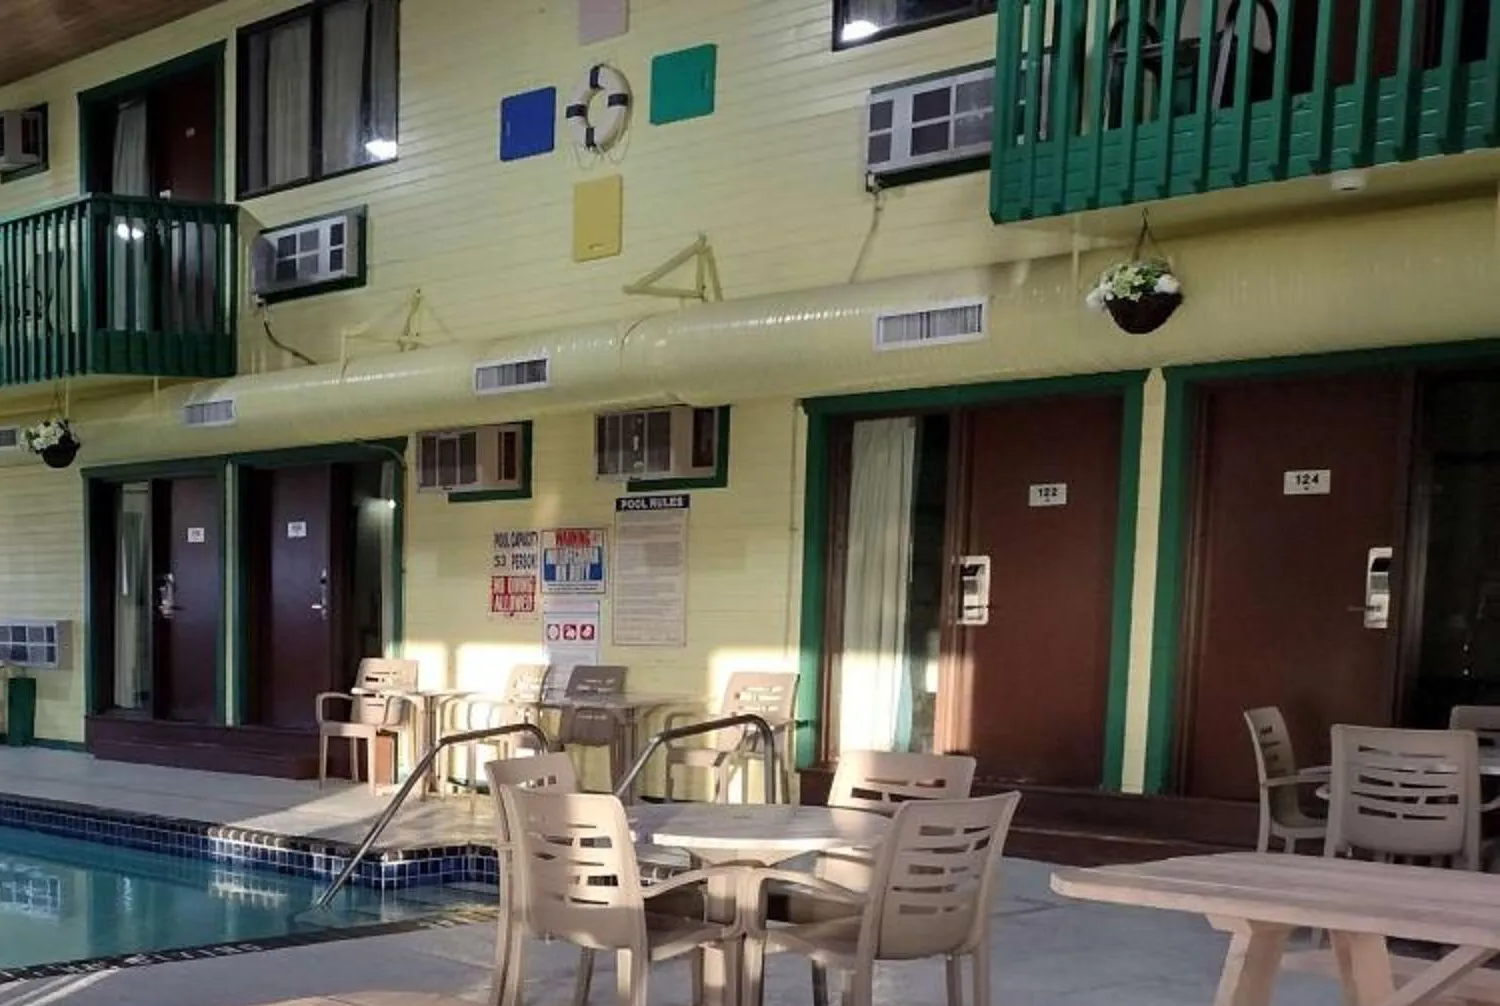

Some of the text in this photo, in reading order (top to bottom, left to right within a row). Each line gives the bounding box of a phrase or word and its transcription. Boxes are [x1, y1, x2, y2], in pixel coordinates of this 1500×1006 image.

[1295, 474, 1320, 485] 124
[1038, 487, 1058, 497] 122
[621, 496, 684, 510] POOL RULES
[494, 554, 507, 568] 53
